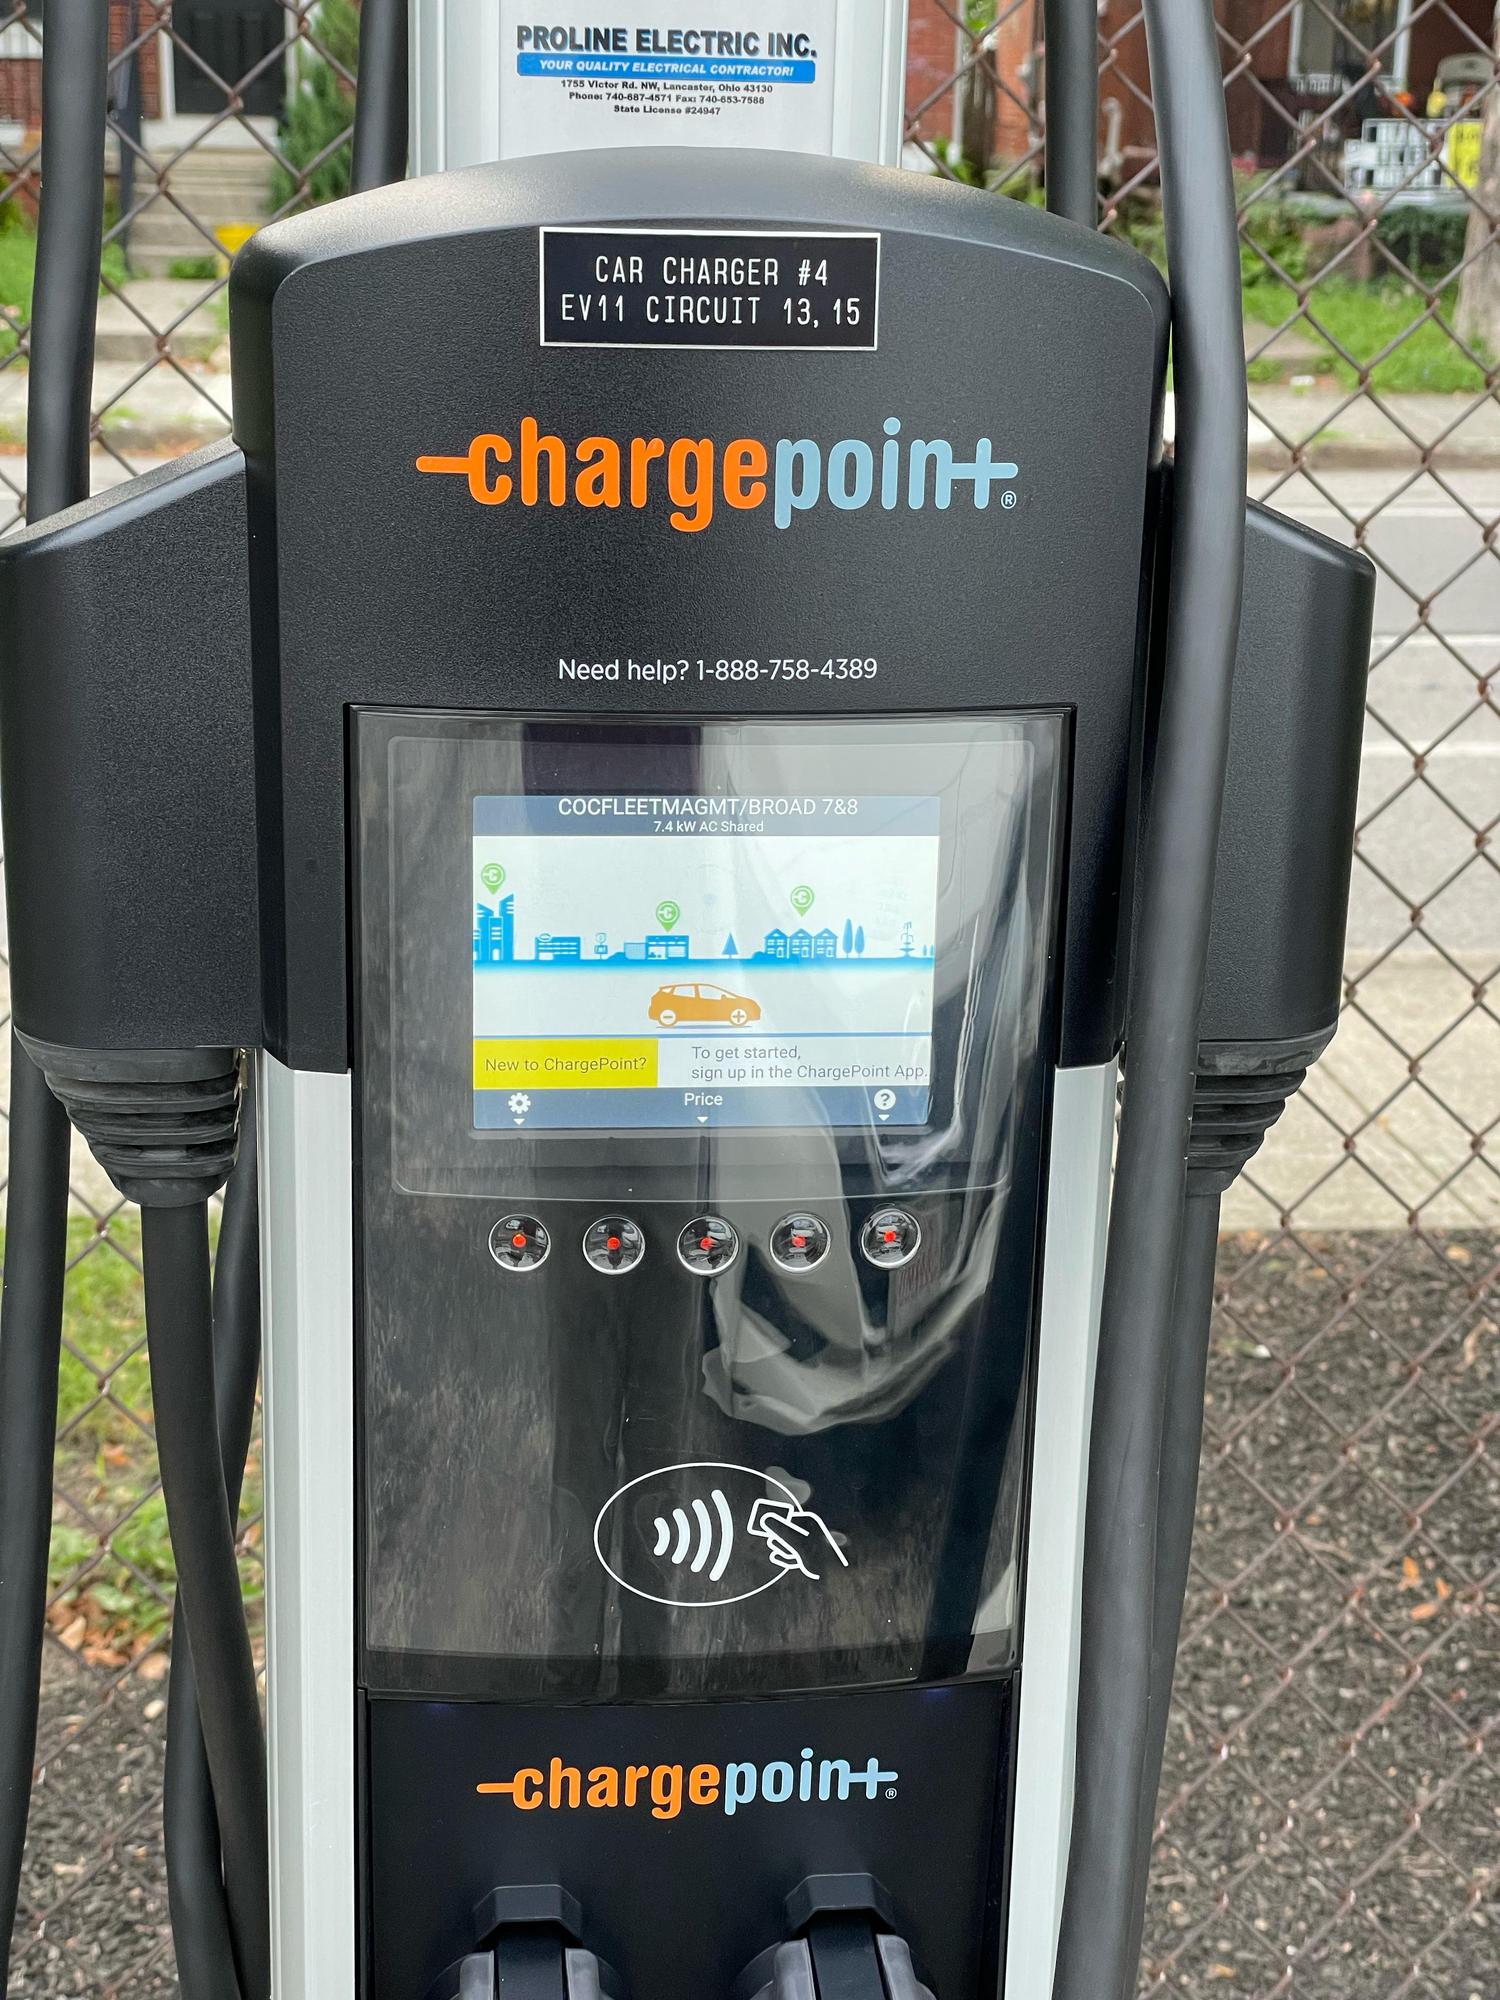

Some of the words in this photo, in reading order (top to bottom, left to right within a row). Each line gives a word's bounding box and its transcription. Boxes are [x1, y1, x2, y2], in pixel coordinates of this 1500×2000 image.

[516, 25, 628, 52] PROLINE
[635, 28, 760, 56] ELECTRIC
[767, 31, 818, 58] INC.
[539, 60, 573, 70] YOUR
[576, 61, 629, 72] QUALITY
[632, 63, 706, 74] ELECTRICAL
[710, 65, 794, 76] CONTRACTOR!
[561, 80, 585, 88] 1755
[588, 80, 619, 89] Victor
[622, 81, 638, 89] Rd.
[641, 82, 660, 91] NW,
[663, 82, 715, 93] Lancaster,
[718, 83, 741, 92] Ohio
[743, 84, 773, 93] 43130
[569, 92, 603, 100] Phone:
[675, 94, 697, 103] Fax:
[614, 105, 640, 113] State
[643, 106, 682, 114] License
[685, 106, 721, 115] #24947
[595, 255, 644, 284] CAR
[662, 256, 779, 286] CHARGER
[798, 259, 828, 287] #4
[561, 294, 625, 323] EV11
[646, 295, 760, 325] CIRCUIT
[783, 297, 820, 329] 13,
[833, 297, 861, 326] 15
[558, 658, 619, 680] Need
[627, 658, 689, 684] help?
[696, 658, 878, 681] 1-888-758-4389
[558, 797, 816, 816] COCFLEETMAGMT/BROAD
[822, 798, 858, 815] 7&8
[653, 820, 673, 832] 7.4
[676, 820, 696, 832] kW
[699, 821, 718, 832] AC
[720, 820, 764, 832] Shared
[691, 1046, 711, 1059] To
[715, 1047, 739, 1062] get
[743, 1045, 801, 1060] started,
[485, 1058, 519, 1072] New
[524, 1058, 539, 1071] to
[544, 1056, 647, 1073] ChargePoint?
[691, 1067, 723, 1082] sign
[727, 1068, 747, 1082] up
[751, 1066, 764, 1078] in
[768, 1065, 793, 1078] the
[796, 1064, 890, 1079] ChargePoint
[894, 1064, 928, 1079] App.
[684, 1092, 723, 1107] Price
